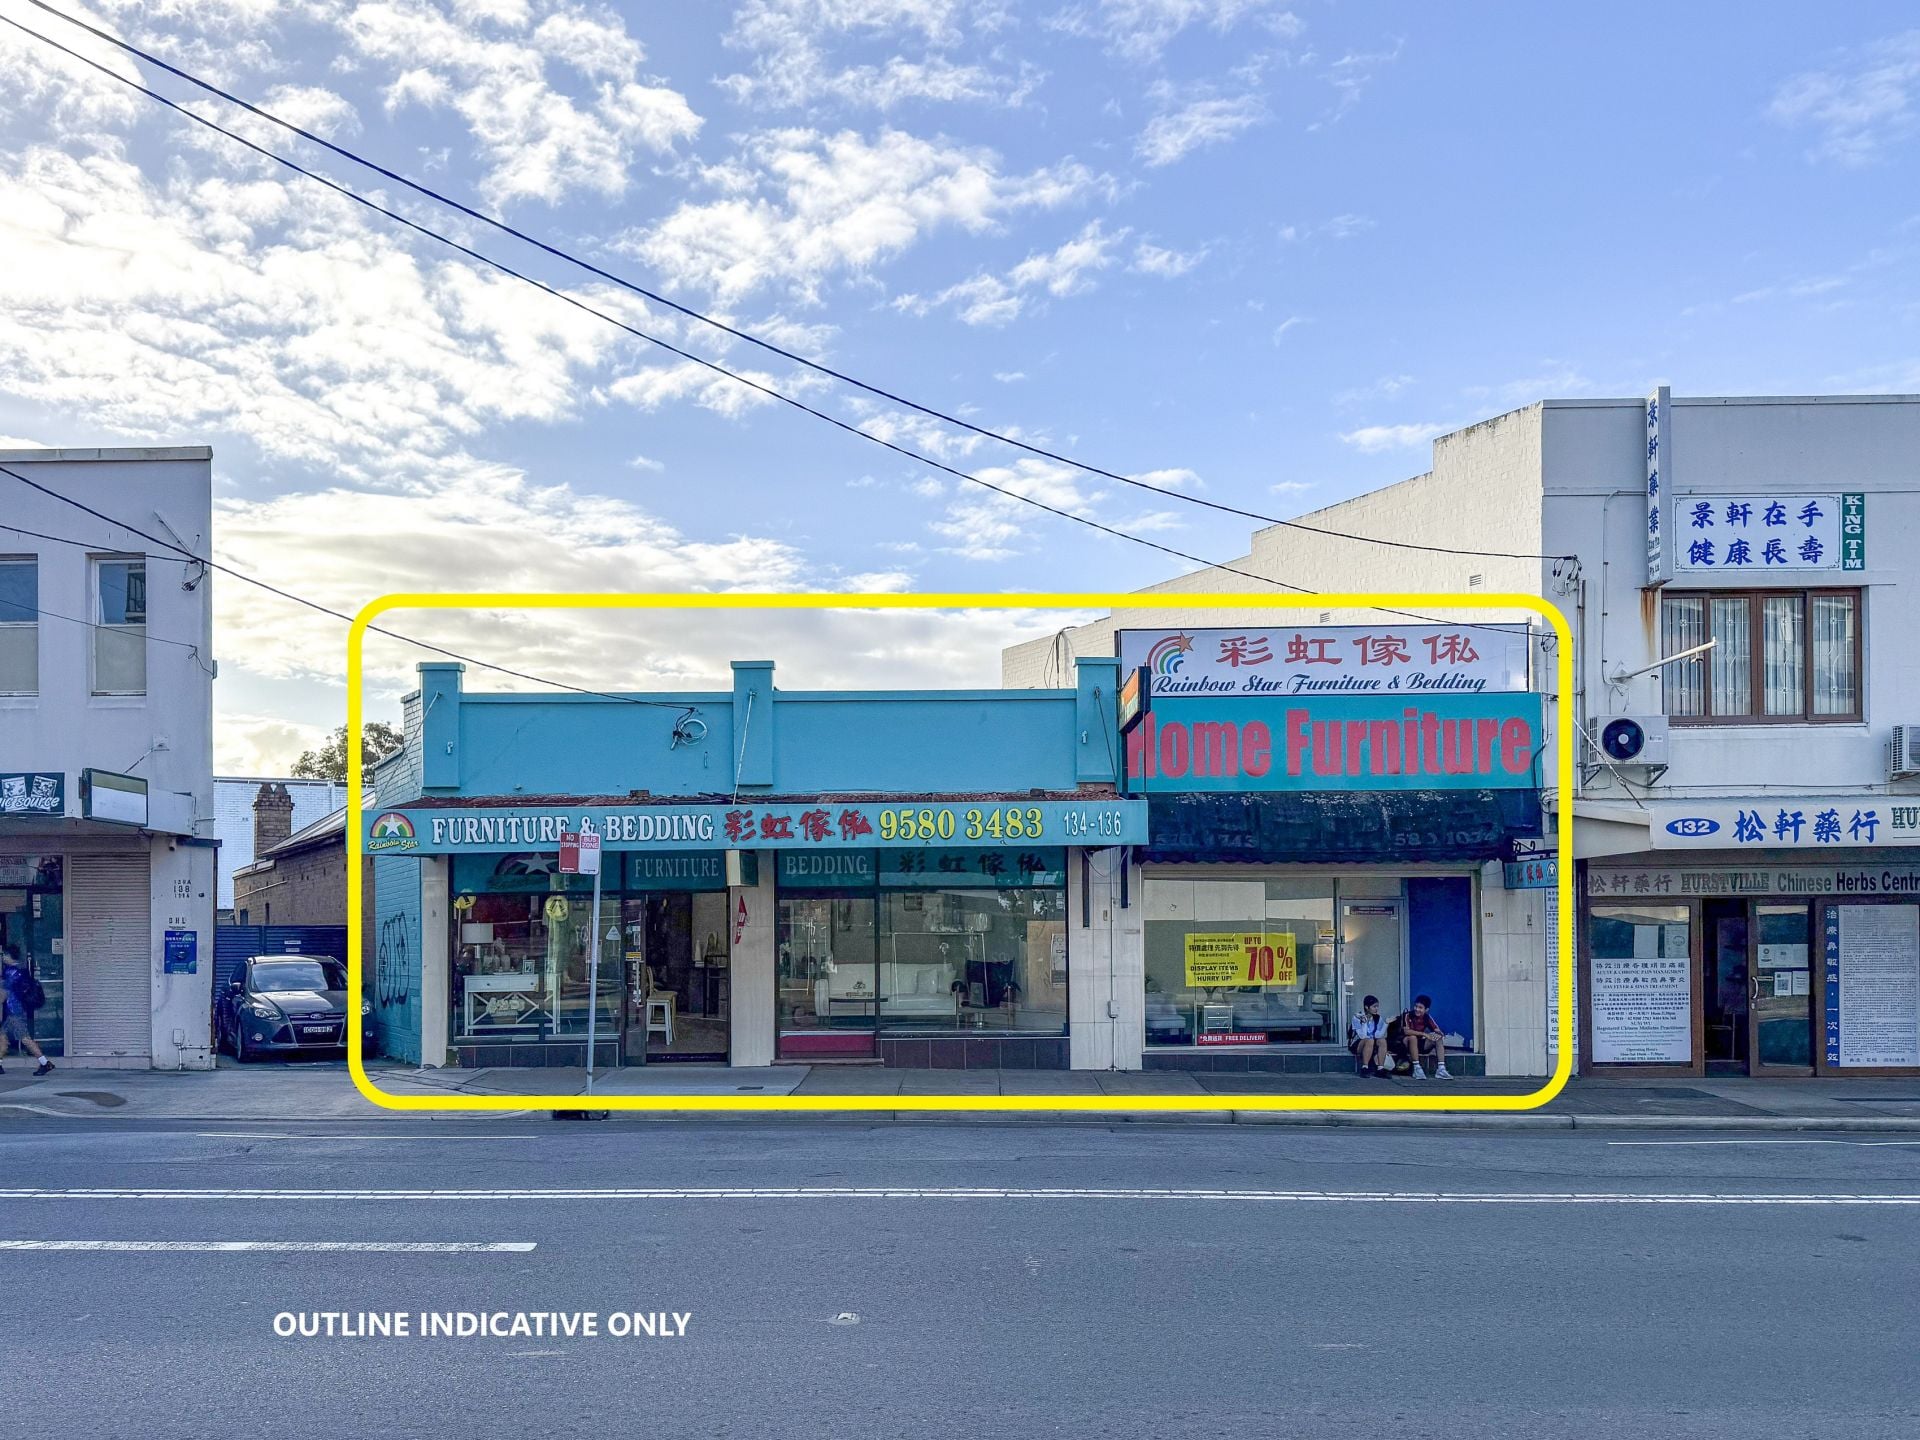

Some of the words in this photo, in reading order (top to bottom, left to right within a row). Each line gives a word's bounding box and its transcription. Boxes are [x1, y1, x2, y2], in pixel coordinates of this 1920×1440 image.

[1690, 500, 1824, 528] 景軒在手
[1844, 495, 1863, 534] KING
[1687, 535, 1824, 565] 健康長壽
[1845, 540, 1863, 569] TIM
[1215, 633, 1480, 668] 彩虹傢俬
[1151, 675, 1236, 693] Rainbow
[1242, 674, 1282, 692] Star
[1287, 673, 1381, 694] Furniture
[1387, 674, 1401, 690] &
[1405, 671, 1486, 693] Bedding
[1127, 708, 1272, 778] Home
[1285, 707, 1532, 775] Furniture
[16, 797, 60, 807] source
[432, 816, 570, 844] FURNITURE
[604, 814, 714, 841] BEDDING
[879, 809, 955, 840] 9580
[965, 808, 1043, 839] 3483
[1063, 810, 1122, 837] 134-136
[1674, 820, 1711, 834] 132
[1732, 808, 1881, 844] 松軒藥行
[1891, 806, 1920, 829] HU
[635, 857, 719, 878] FURNITURE
[785, 855, 868, 875] BEDDING
[1681, 873, 1770, 893] HURSTVILLE
[1778, 873, 1832, 892] Chinese
[1836, 872, 1877, 891] Herbs
[1243, 937, 1253, 945] UP
[1253, 937, 1262, 945] TO
[1245, 945, 1274, 982] 70
[1278, 971, 1293, 981] OFF
